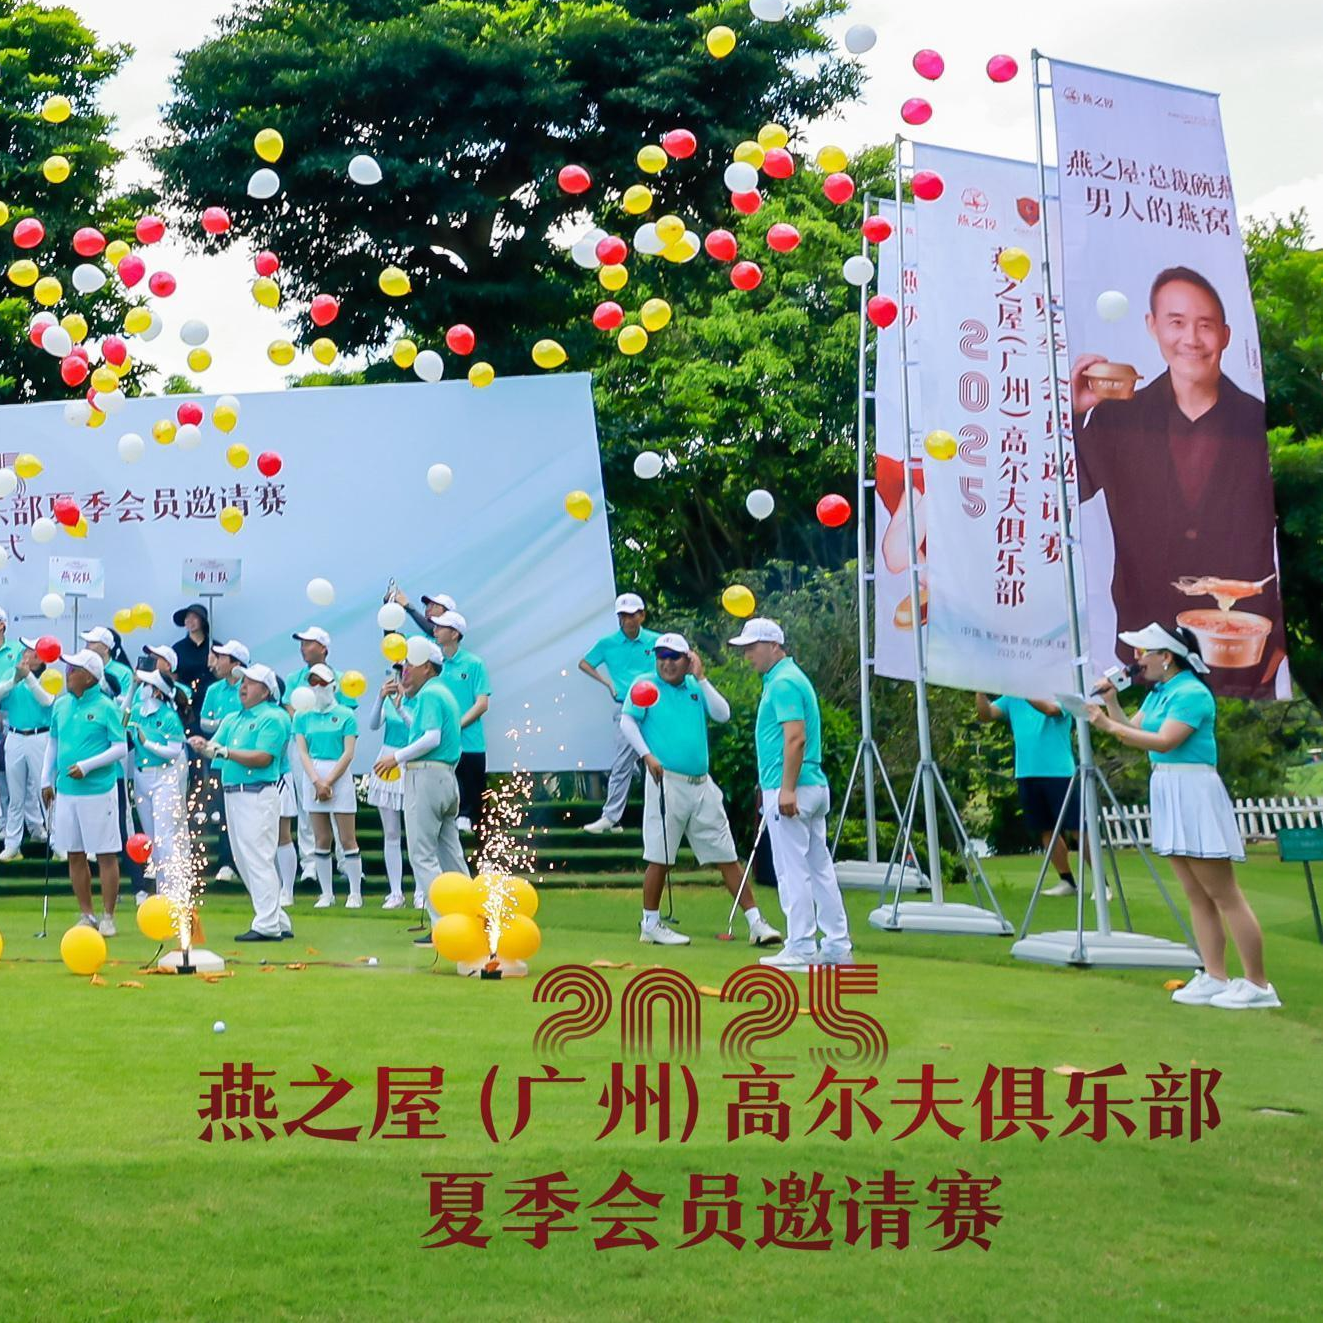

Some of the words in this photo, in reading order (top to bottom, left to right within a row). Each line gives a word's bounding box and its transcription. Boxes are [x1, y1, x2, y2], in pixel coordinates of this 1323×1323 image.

[1086, 186, 1231, 236] 男人的燕窝
[959, 319, 990, 518] 2025
